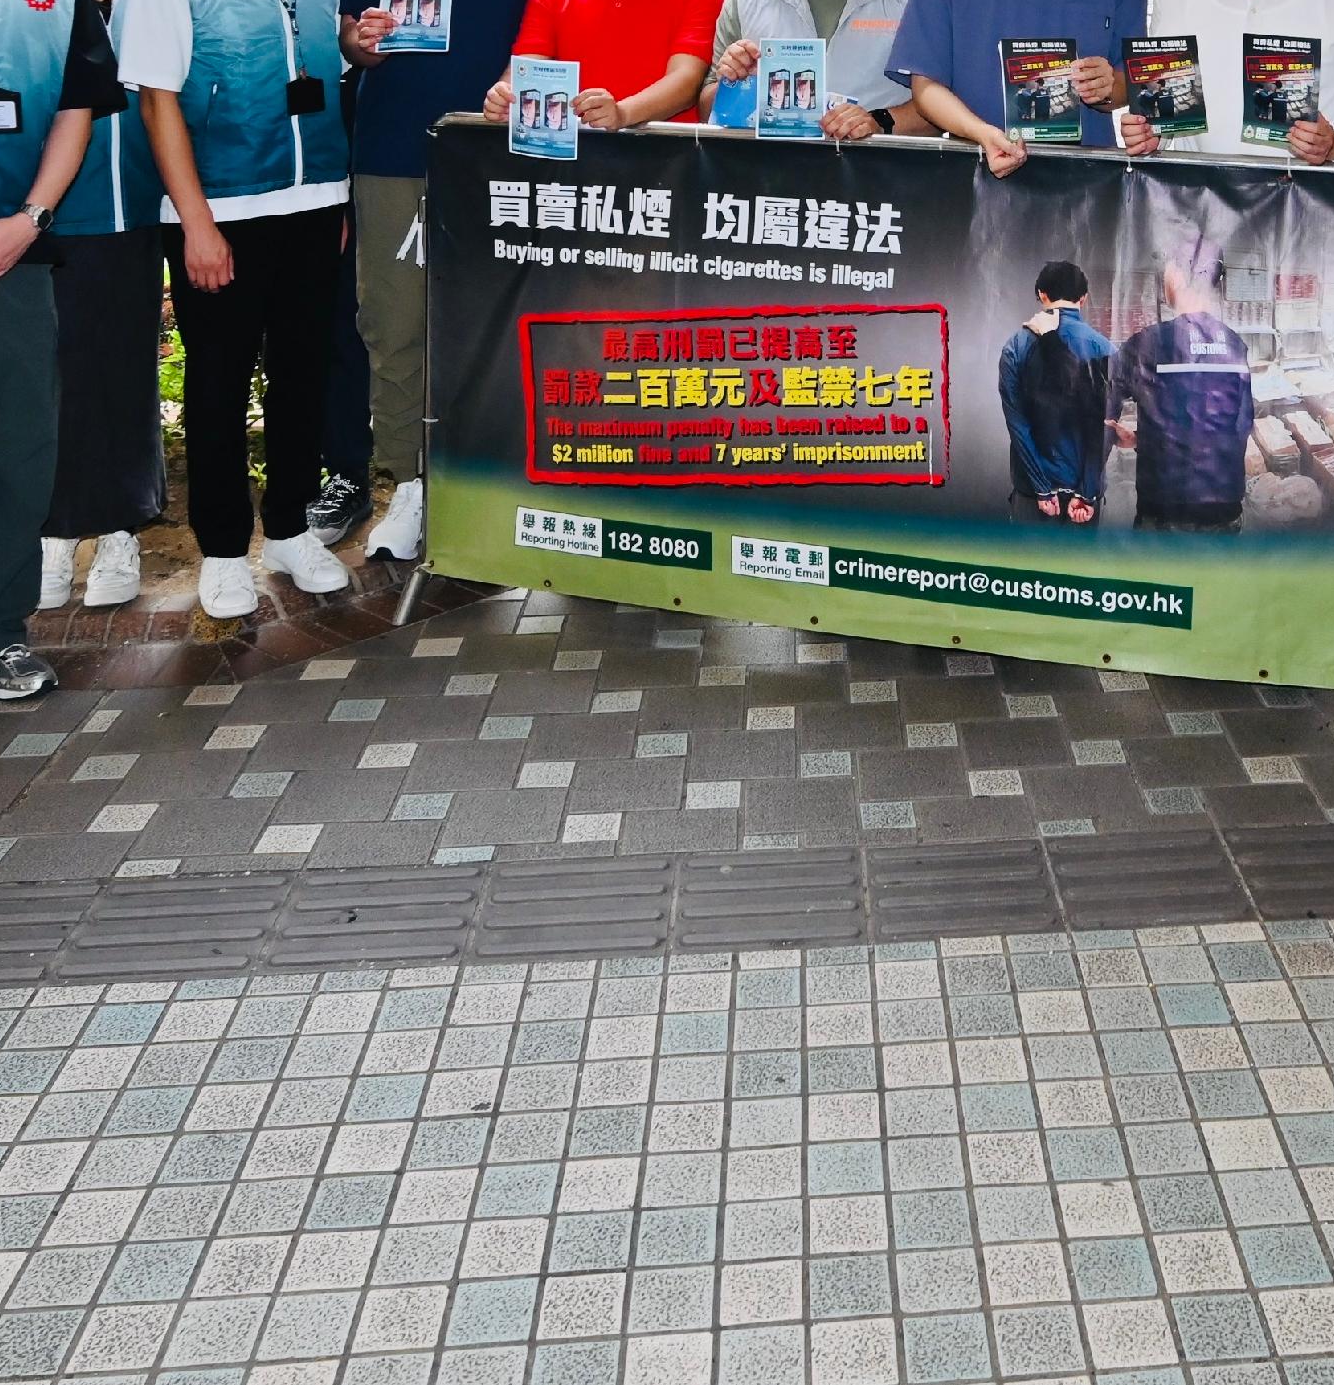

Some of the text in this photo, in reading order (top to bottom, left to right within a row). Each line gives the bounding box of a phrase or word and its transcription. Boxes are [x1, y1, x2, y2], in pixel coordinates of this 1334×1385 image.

[488, 180, 905, 256] 買賣私煙 均屬違法
[494, 239, 896, 292] Buying or selling illicit cigarettes is illegal
[603, 324, 859, 363] 最高刑罰已提高至
[543, 365, 935, 409] 罰款二百萬元及監禁七年
[546, 414, 929, 442] The maximum penalty has been raised to a
[551, 441, 573, 465] $2
[576, 442, 635, 465] million
[638, 442, 674, 465] fine
[676, 442, 713, 464] and
[715, 442, 727, 464] 7
[792, 440, 927, 468] imprisonment
[521, 512, 598, 541] 舉報熱線
[520, 530, 700, 560] Reporting Hotline 182 8080
[740, 541, 824, 569] 舉報電郵
[739, 557, 1185, 617] Reporting Email crimereport@customs.gov.hk
